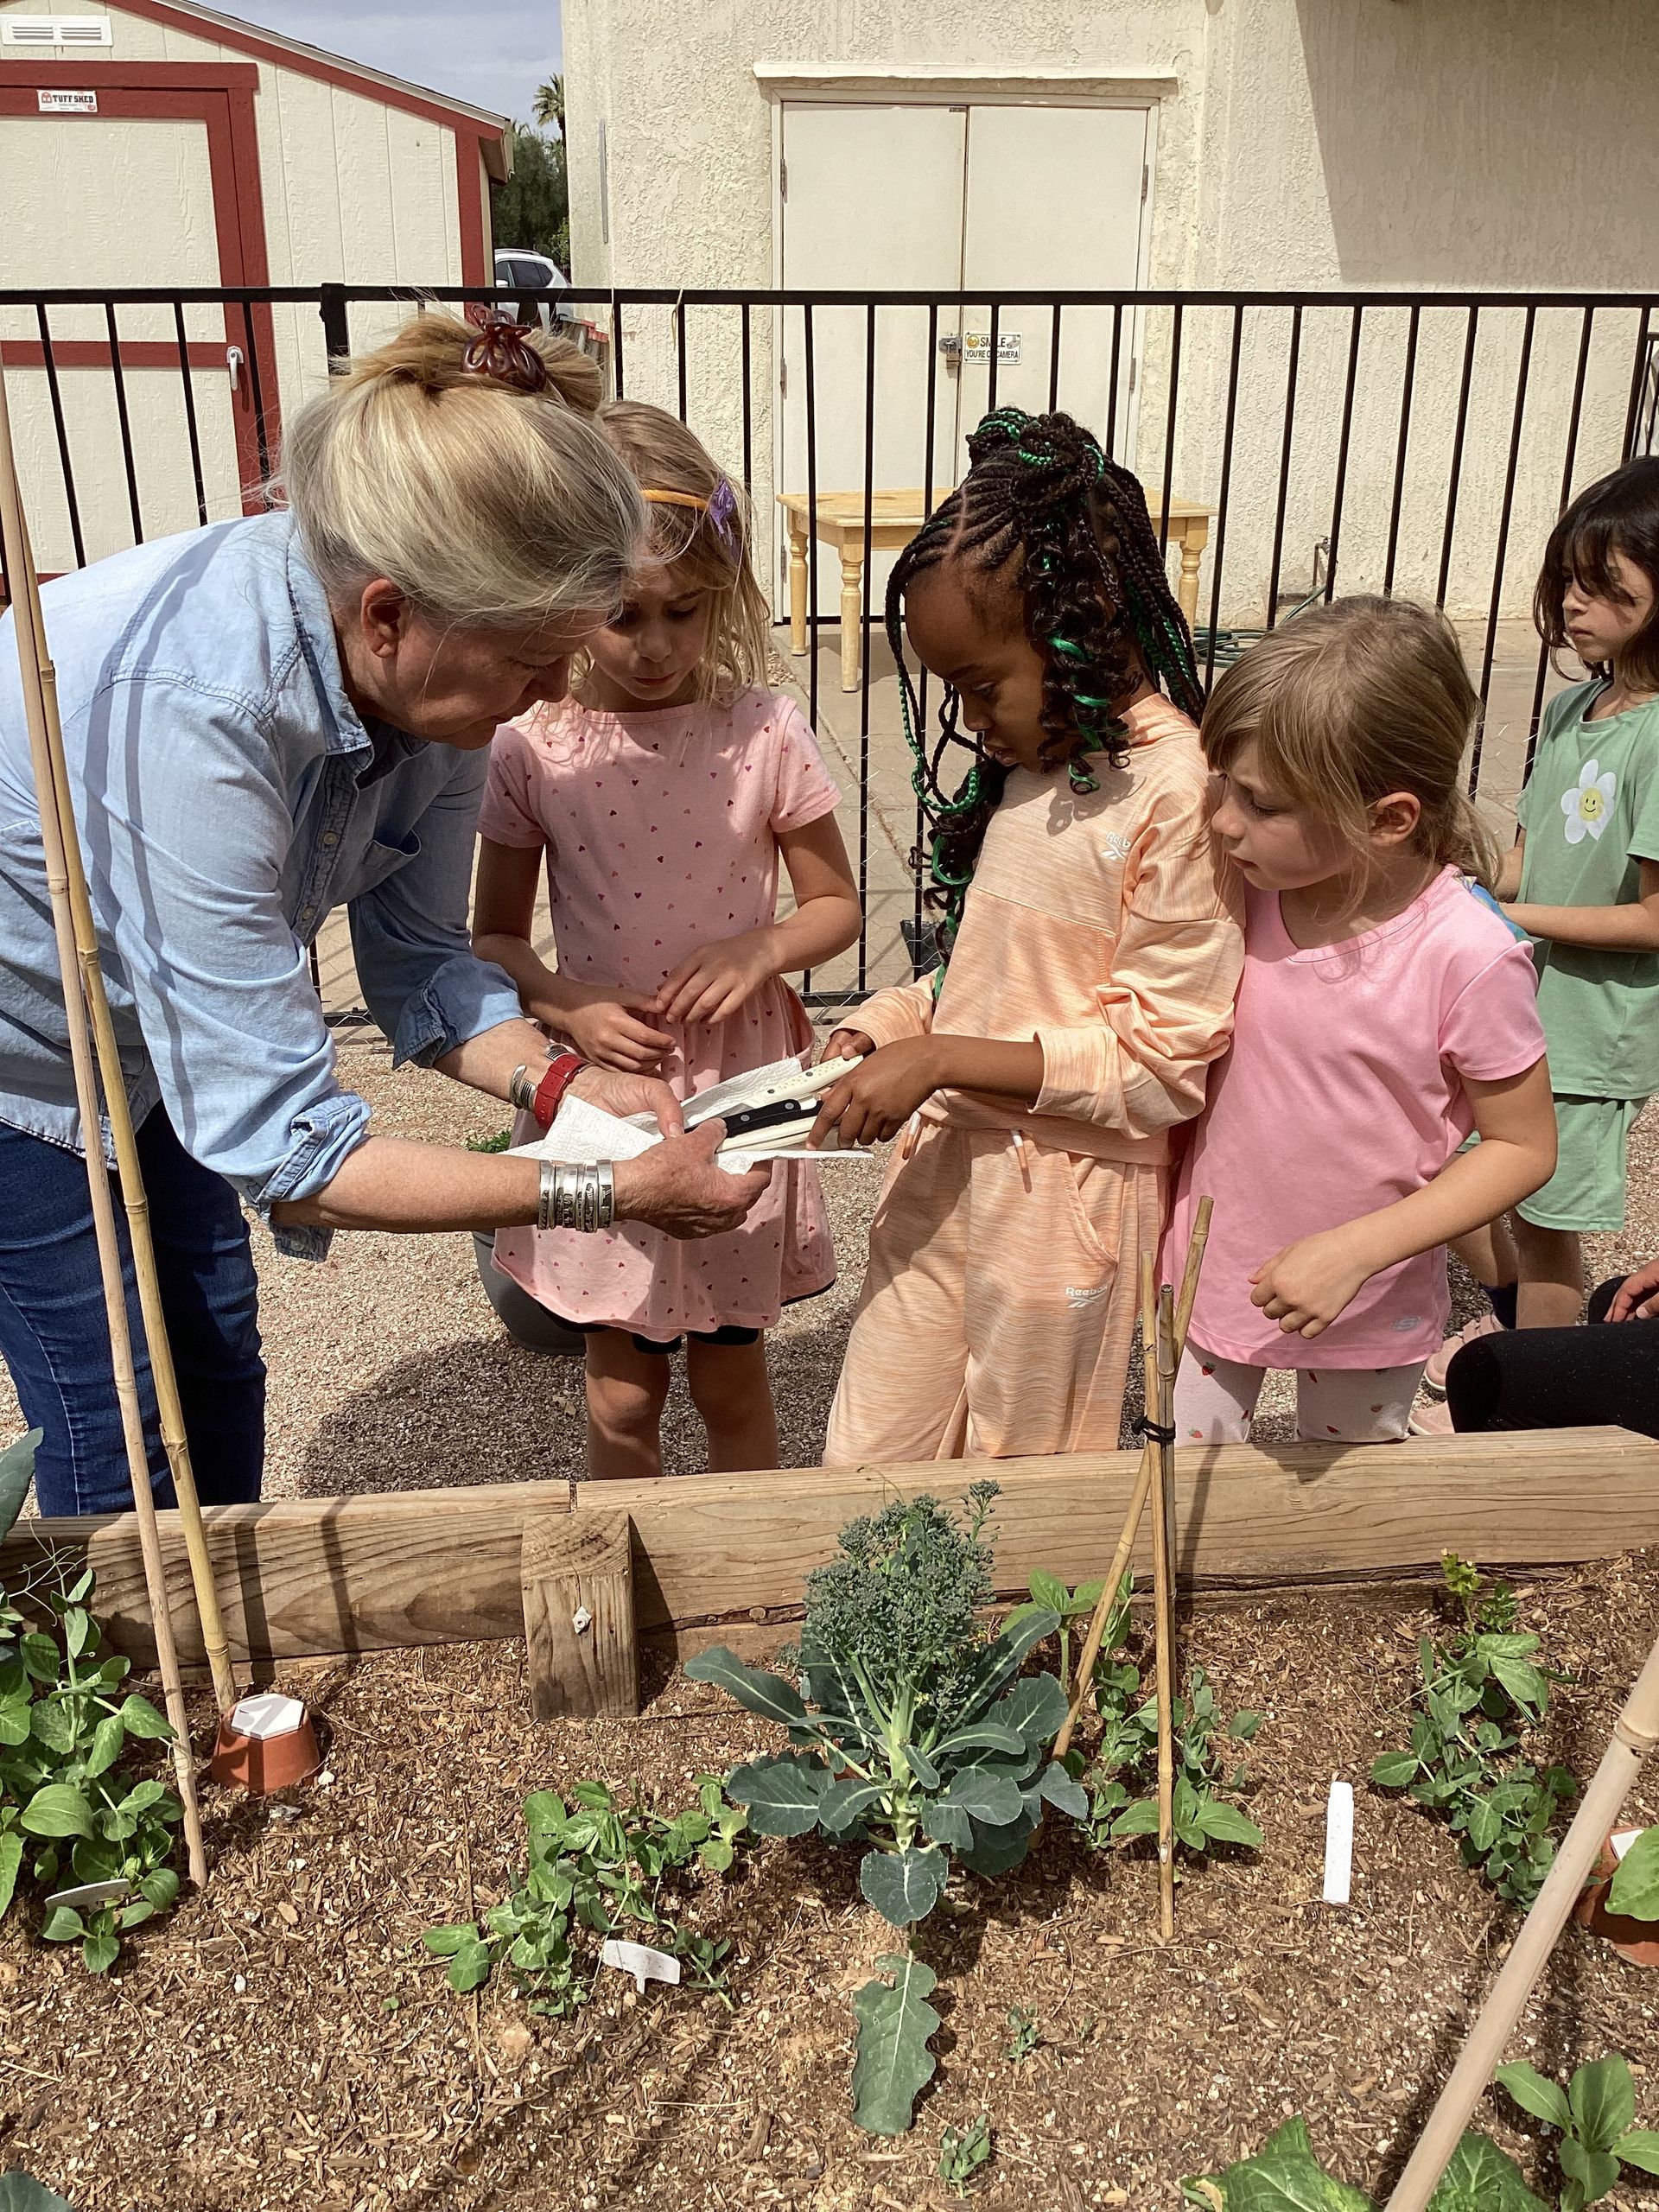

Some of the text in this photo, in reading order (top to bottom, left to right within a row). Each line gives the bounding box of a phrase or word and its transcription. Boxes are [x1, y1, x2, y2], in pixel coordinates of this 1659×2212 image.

[73, 95, 94, 104] SHED
[980, 336, 1007, 347] SMLE
[966, 349, 986, 359] YOU'RE
